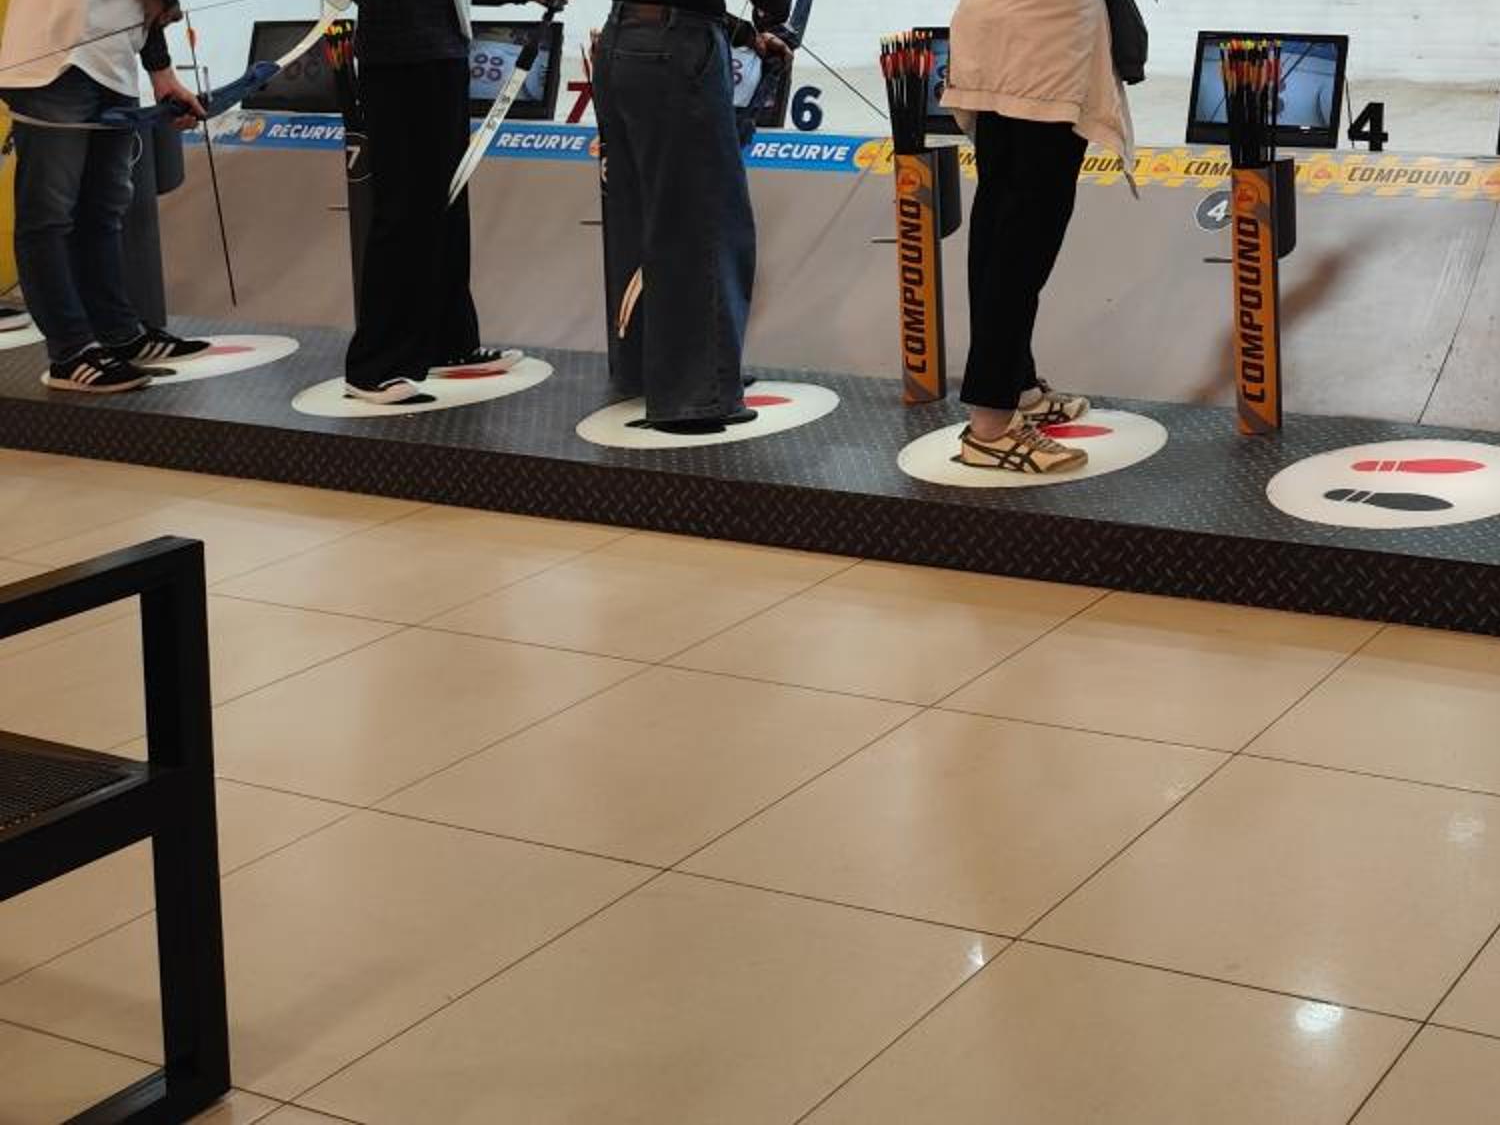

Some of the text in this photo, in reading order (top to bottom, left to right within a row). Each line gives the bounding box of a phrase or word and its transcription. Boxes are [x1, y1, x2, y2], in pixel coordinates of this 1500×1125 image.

[567, 82, 592, 124] 7
[791, 86, 823, 131] 6
[267, 123, 345, 140] RECURVE
[496, 132, 587, 150] RECURVE
[1348, 102, 1389, 151] 4
[750, 141, 851, 162] RECURVE
[1348, 165, 1471, 186] COMPOUND
[1206, 200, 1232, 222] 4
[899, 198, 927, 374] COMPOUND
[1236, 215, 1265, 404] COMPOUND
